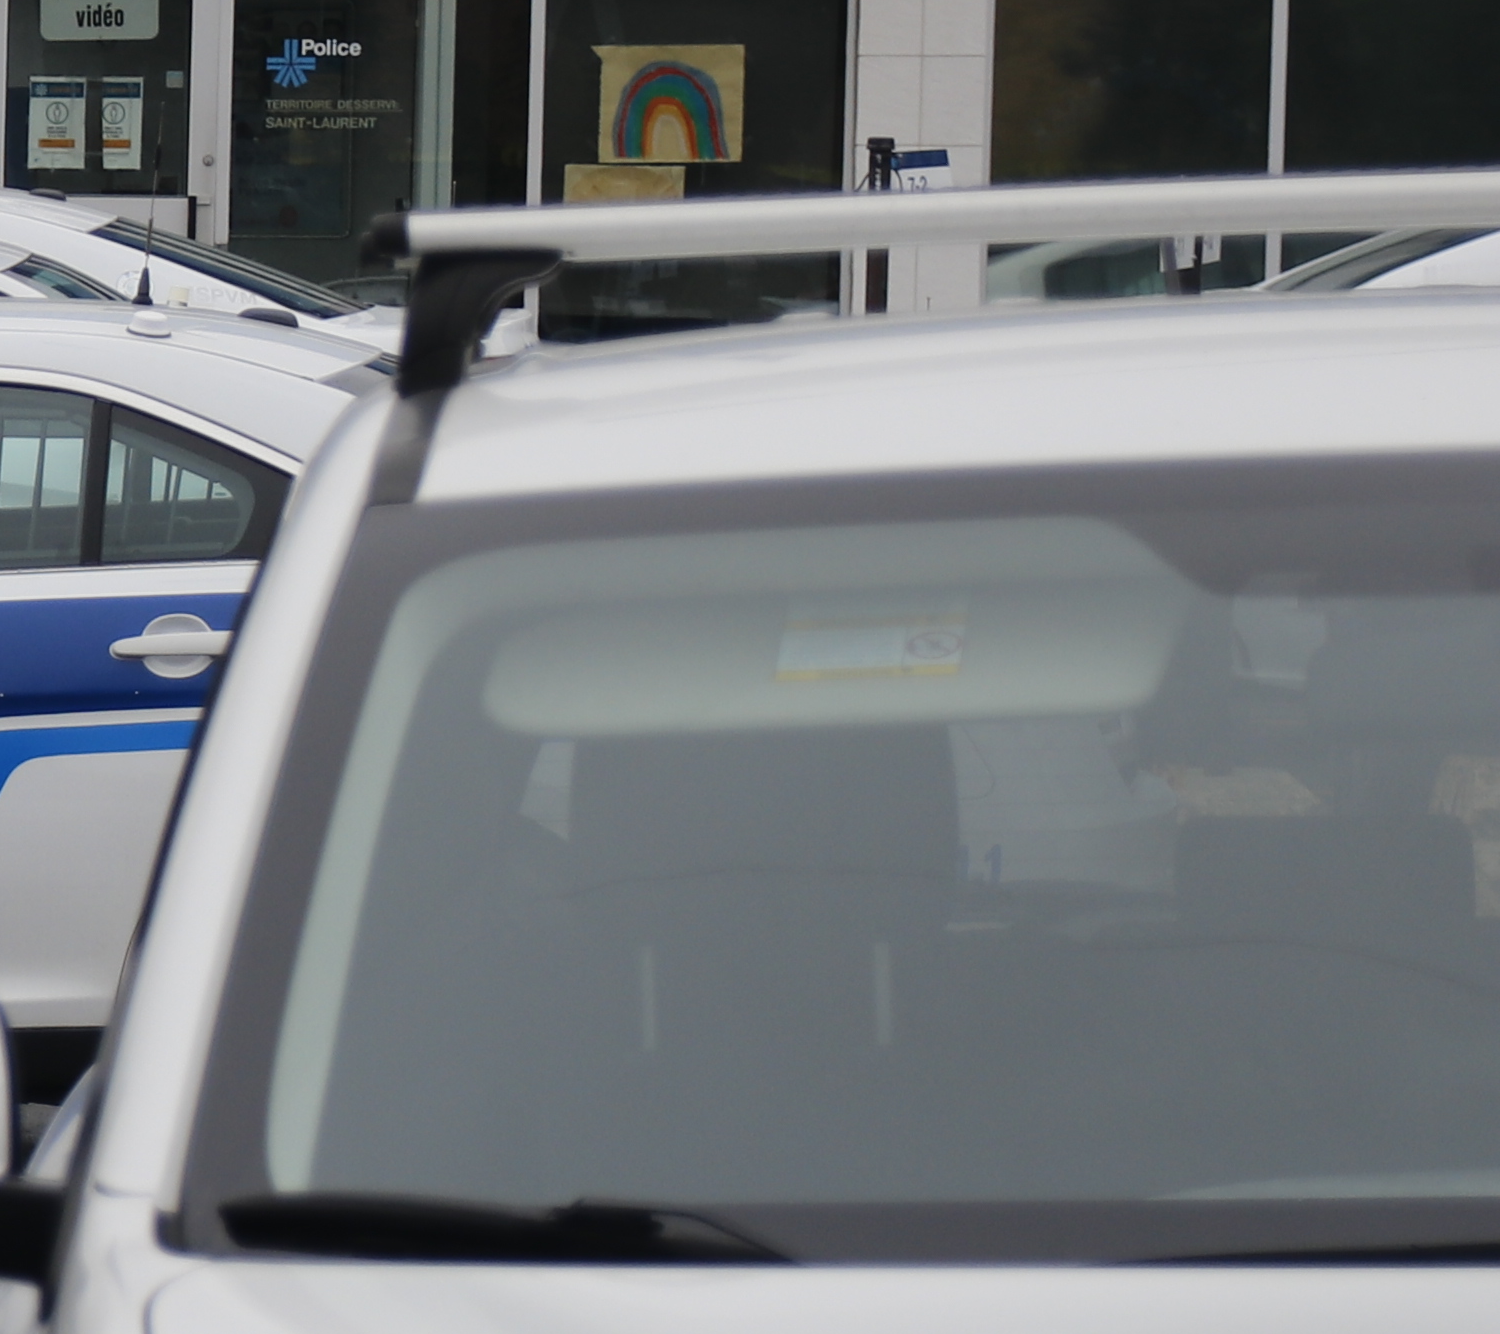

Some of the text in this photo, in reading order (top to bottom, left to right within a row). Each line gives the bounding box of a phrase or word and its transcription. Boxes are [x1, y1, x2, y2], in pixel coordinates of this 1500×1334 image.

[75, 2, 125, 28] vidéo
[301, 38, 363, 57] Police
[265, 99, 334, 111] TERRITOIRE
[265, 116, 377, 130] SAINT-LAURENT
